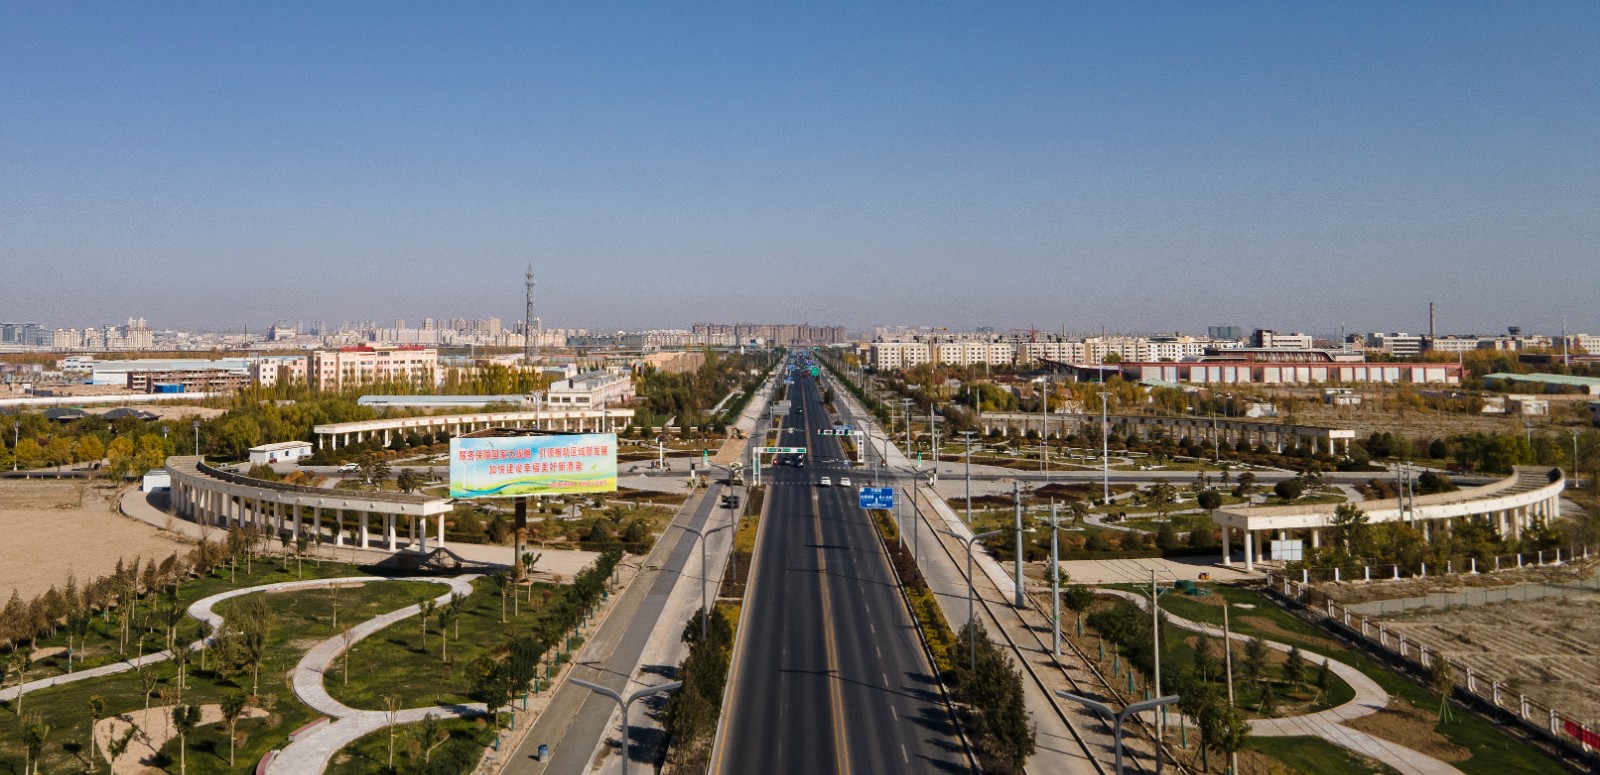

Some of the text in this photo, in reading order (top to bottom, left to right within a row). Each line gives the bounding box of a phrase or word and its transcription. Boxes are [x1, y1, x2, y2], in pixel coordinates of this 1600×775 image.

[489, 461, 582, 475] 加快建设幸福美好新酒泉
